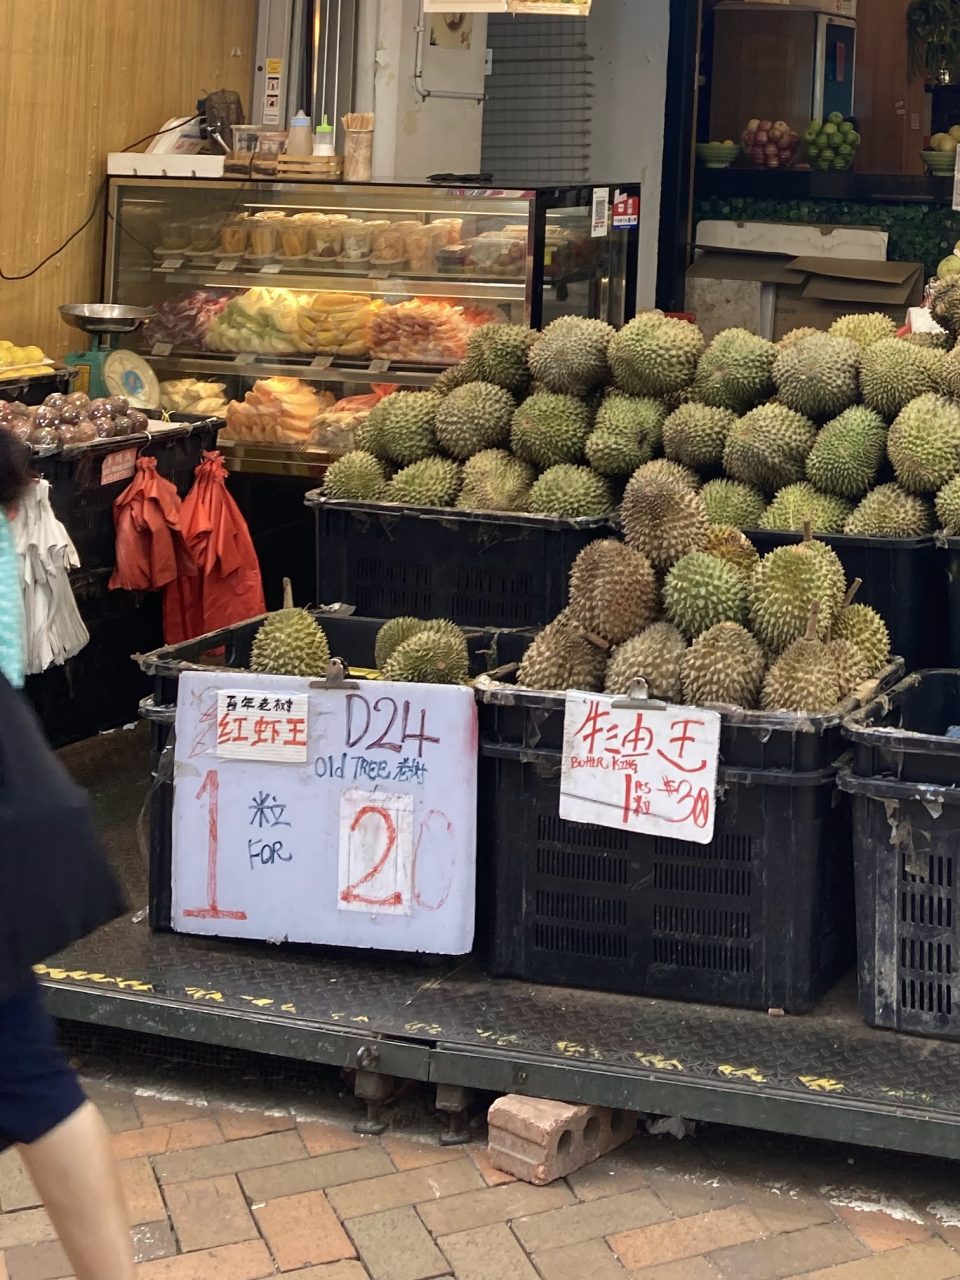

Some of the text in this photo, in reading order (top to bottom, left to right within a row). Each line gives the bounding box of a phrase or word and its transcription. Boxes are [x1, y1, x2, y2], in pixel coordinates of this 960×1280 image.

[226, 694, 293, 713] 百年老树
[217, 712, 307, 747] 红虾王
[345, 693, 440, 758] D24
[573, 701, 707, 773] 牛油王
[249, 791, 291, 828] 粒
[183, 770, 247, 920] 1
[248, 838, 293, 870] FOR
